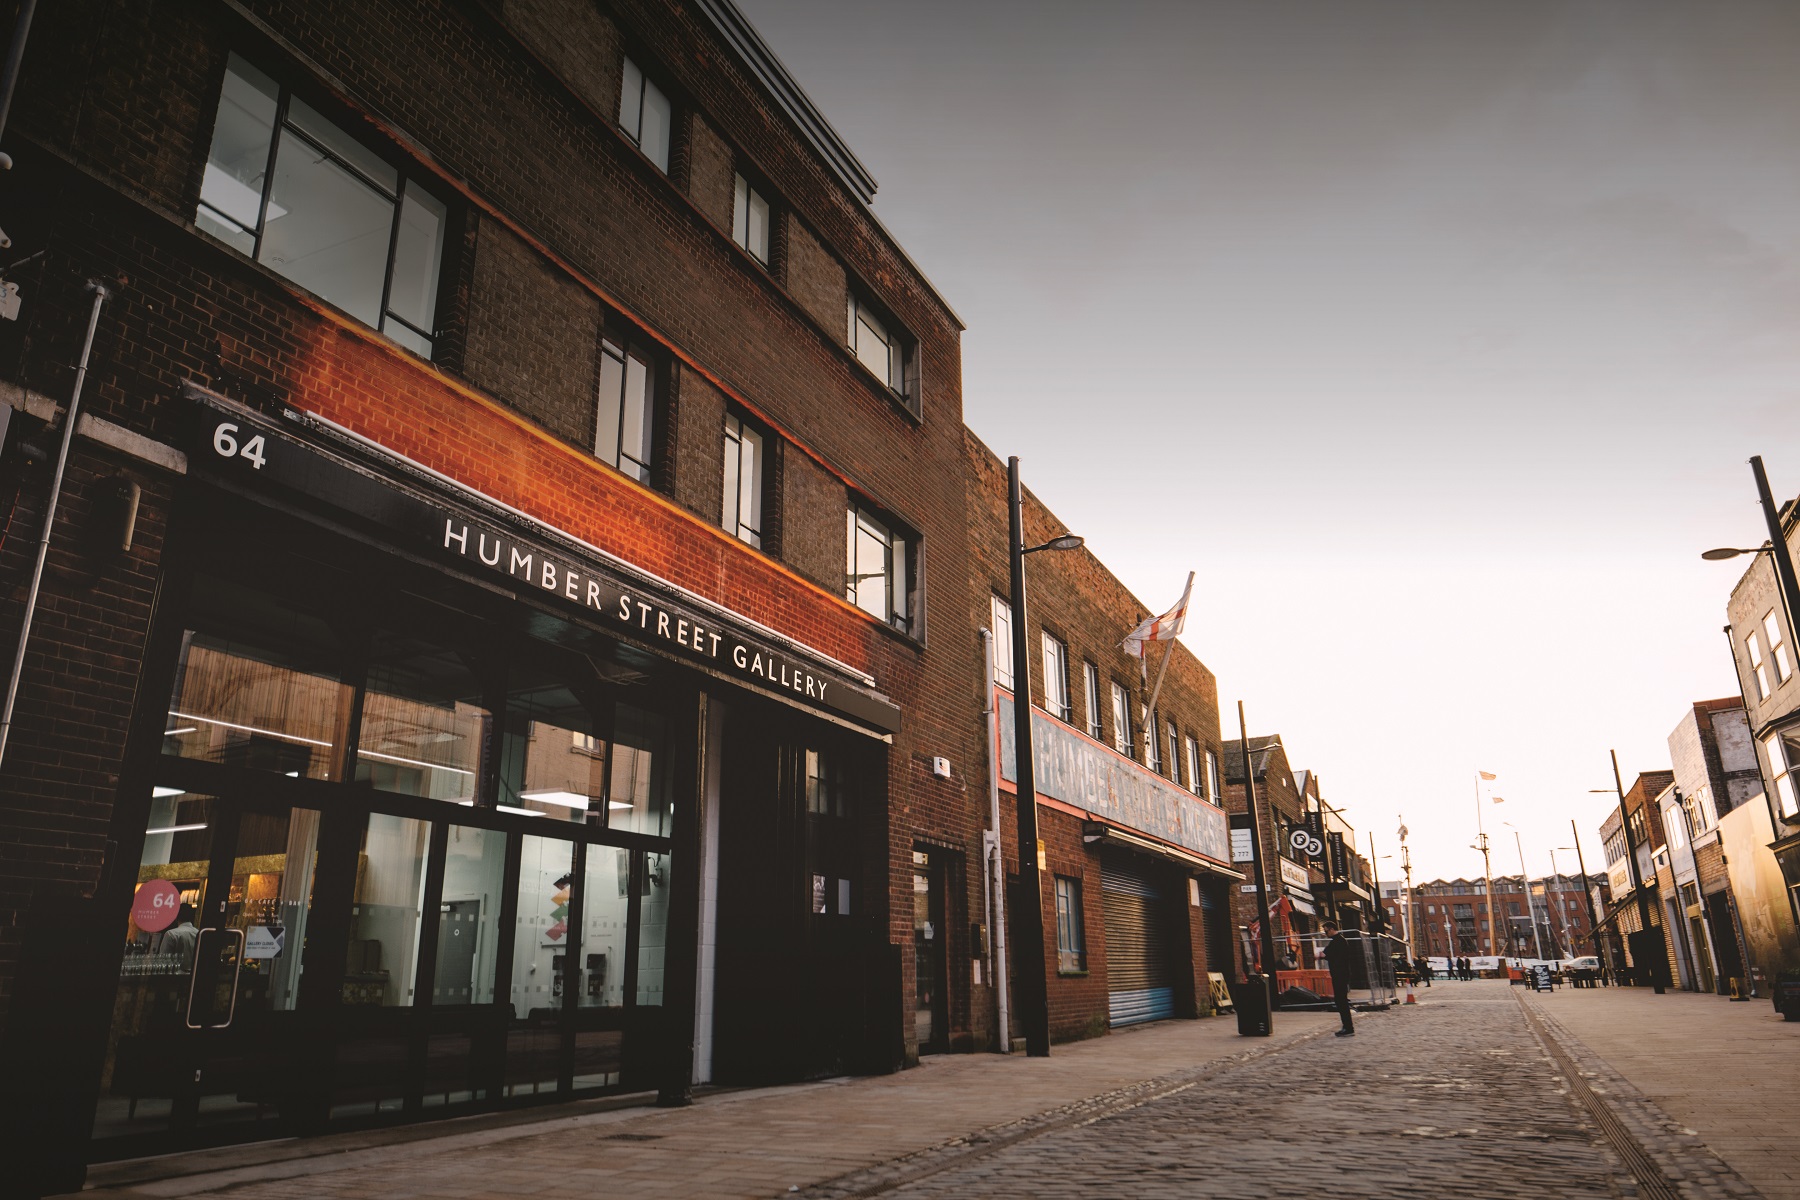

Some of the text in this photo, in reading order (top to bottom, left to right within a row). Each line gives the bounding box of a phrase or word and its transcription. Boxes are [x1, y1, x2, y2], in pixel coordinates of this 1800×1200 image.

[213, 422, 266, 470] 64
[444, 519, 828, 701] HUMBER STREET GALLERY
[153, 893, 175, 908] 64
